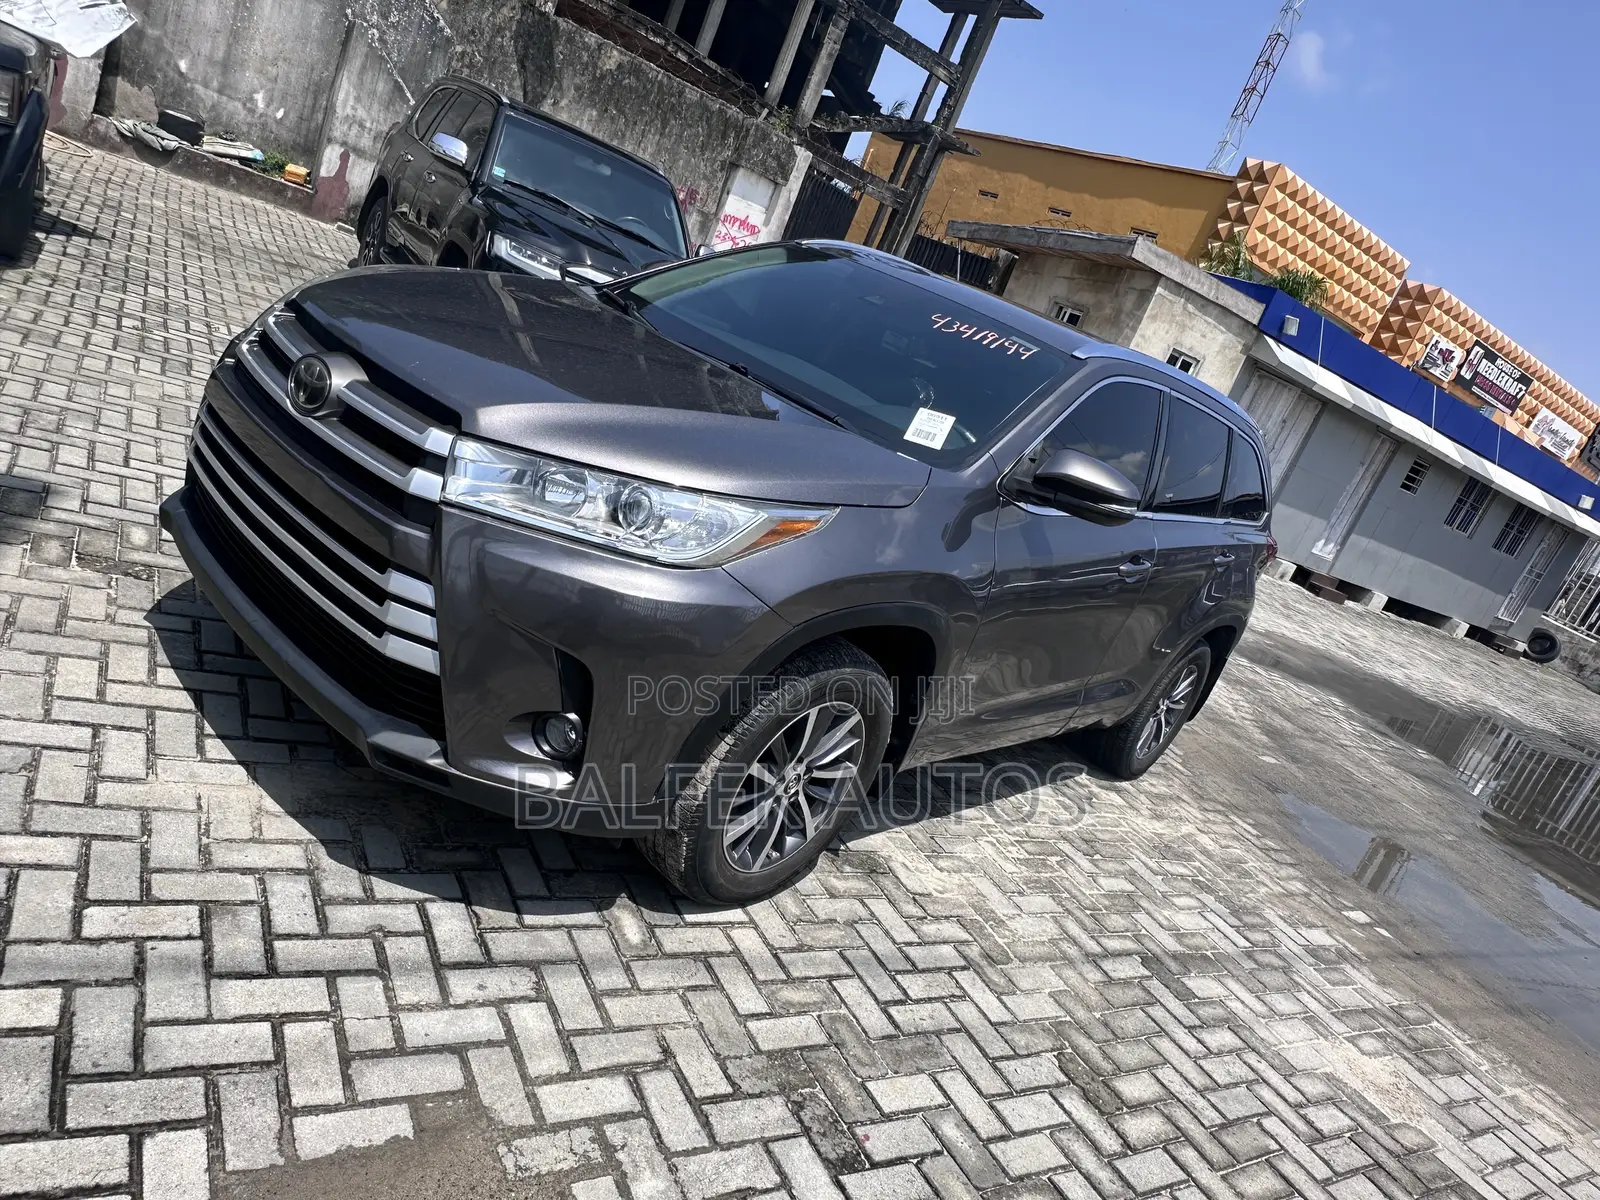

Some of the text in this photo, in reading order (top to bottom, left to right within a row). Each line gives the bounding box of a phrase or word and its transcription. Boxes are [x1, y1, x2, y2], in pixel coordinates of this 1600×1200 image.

[931, 313, 1037, 360] 43419194
[1494, 357, 1521, 380] HOUSE OF
